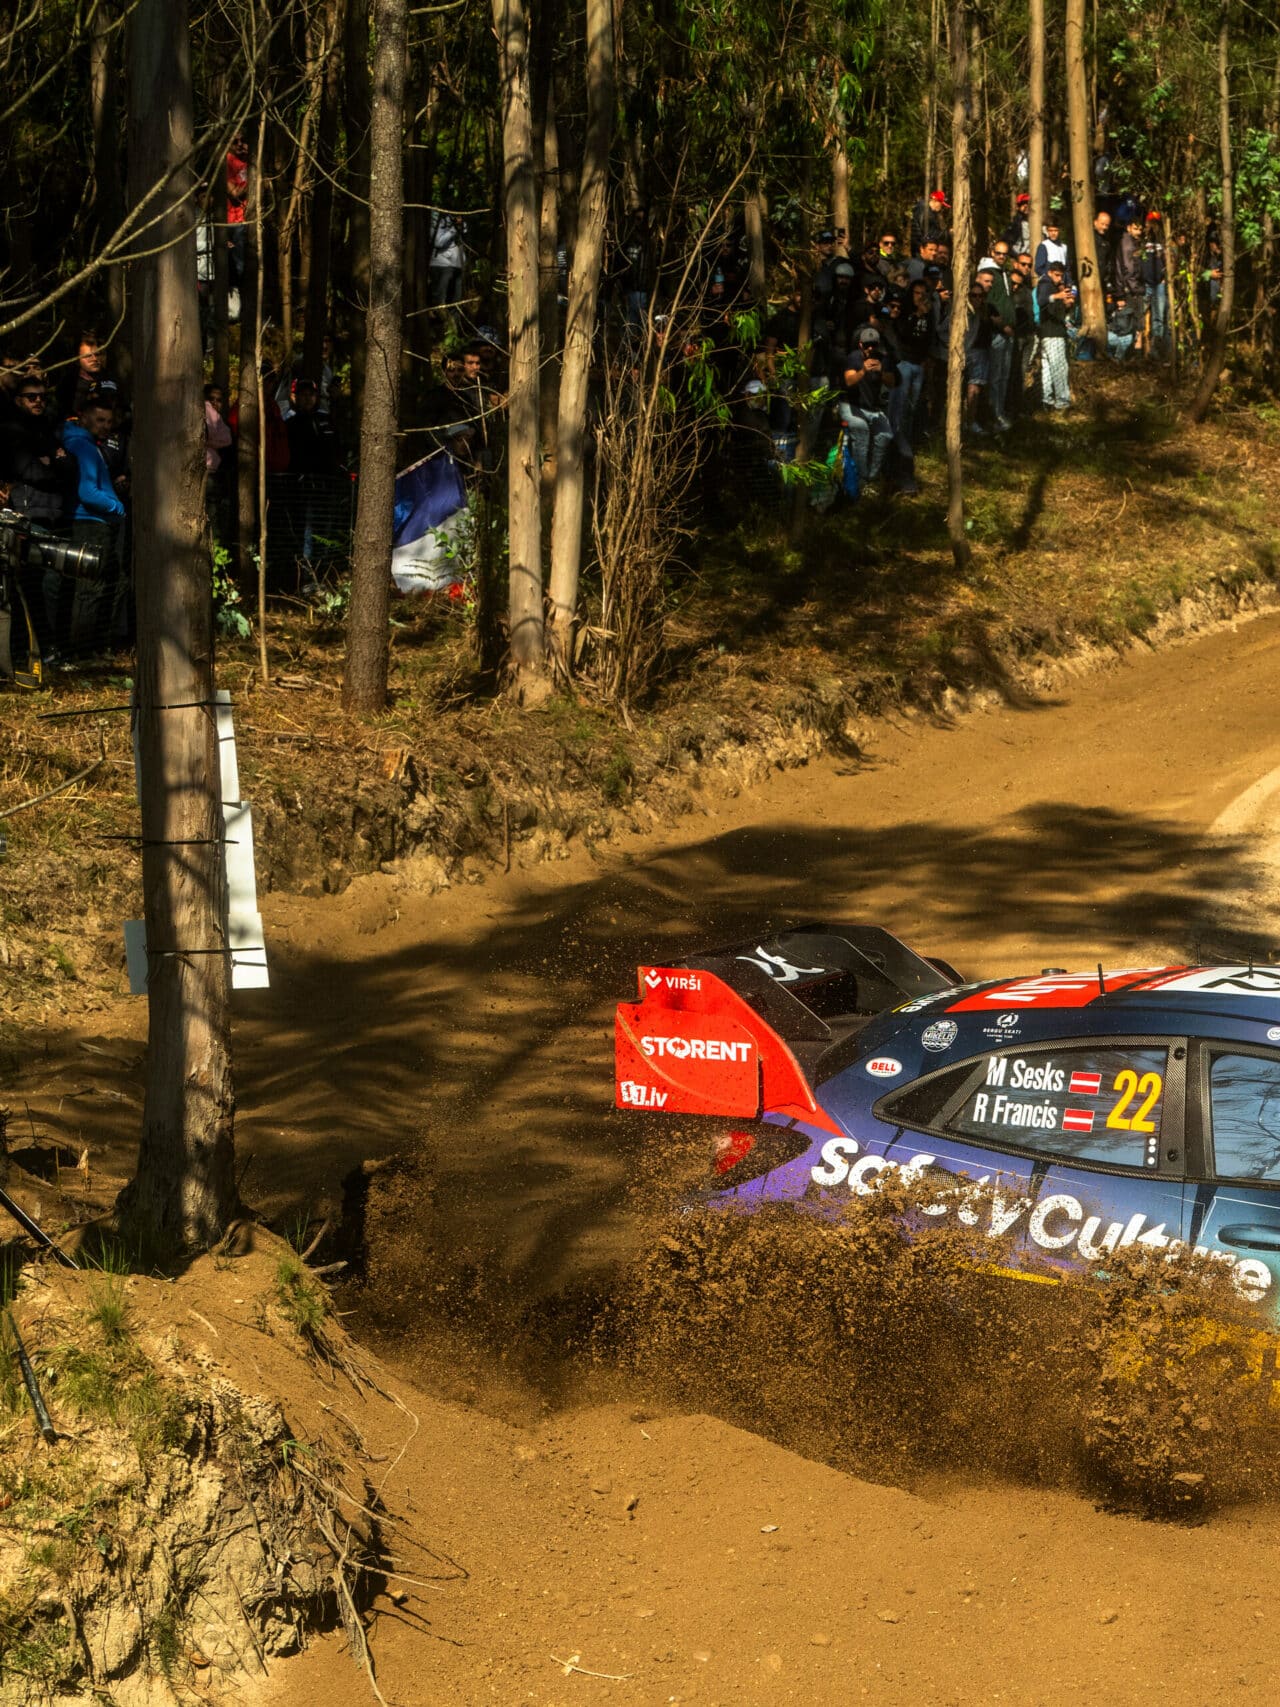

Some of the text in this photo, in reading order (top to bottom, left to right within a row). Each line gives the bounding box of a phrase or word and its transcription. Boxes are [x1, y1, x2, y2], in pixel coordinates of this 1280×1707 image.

[665, 974, 701, 991] VIRŠI
[640, 1036, 752, 1062] STORENT
[871, 1062, 897, 1072] BELL
[986, 1056, 1065, 1092] M Sesks
[972, 1093, 1057, 1129] R Francis
[1106, 1069, 1162, 1132] 22
